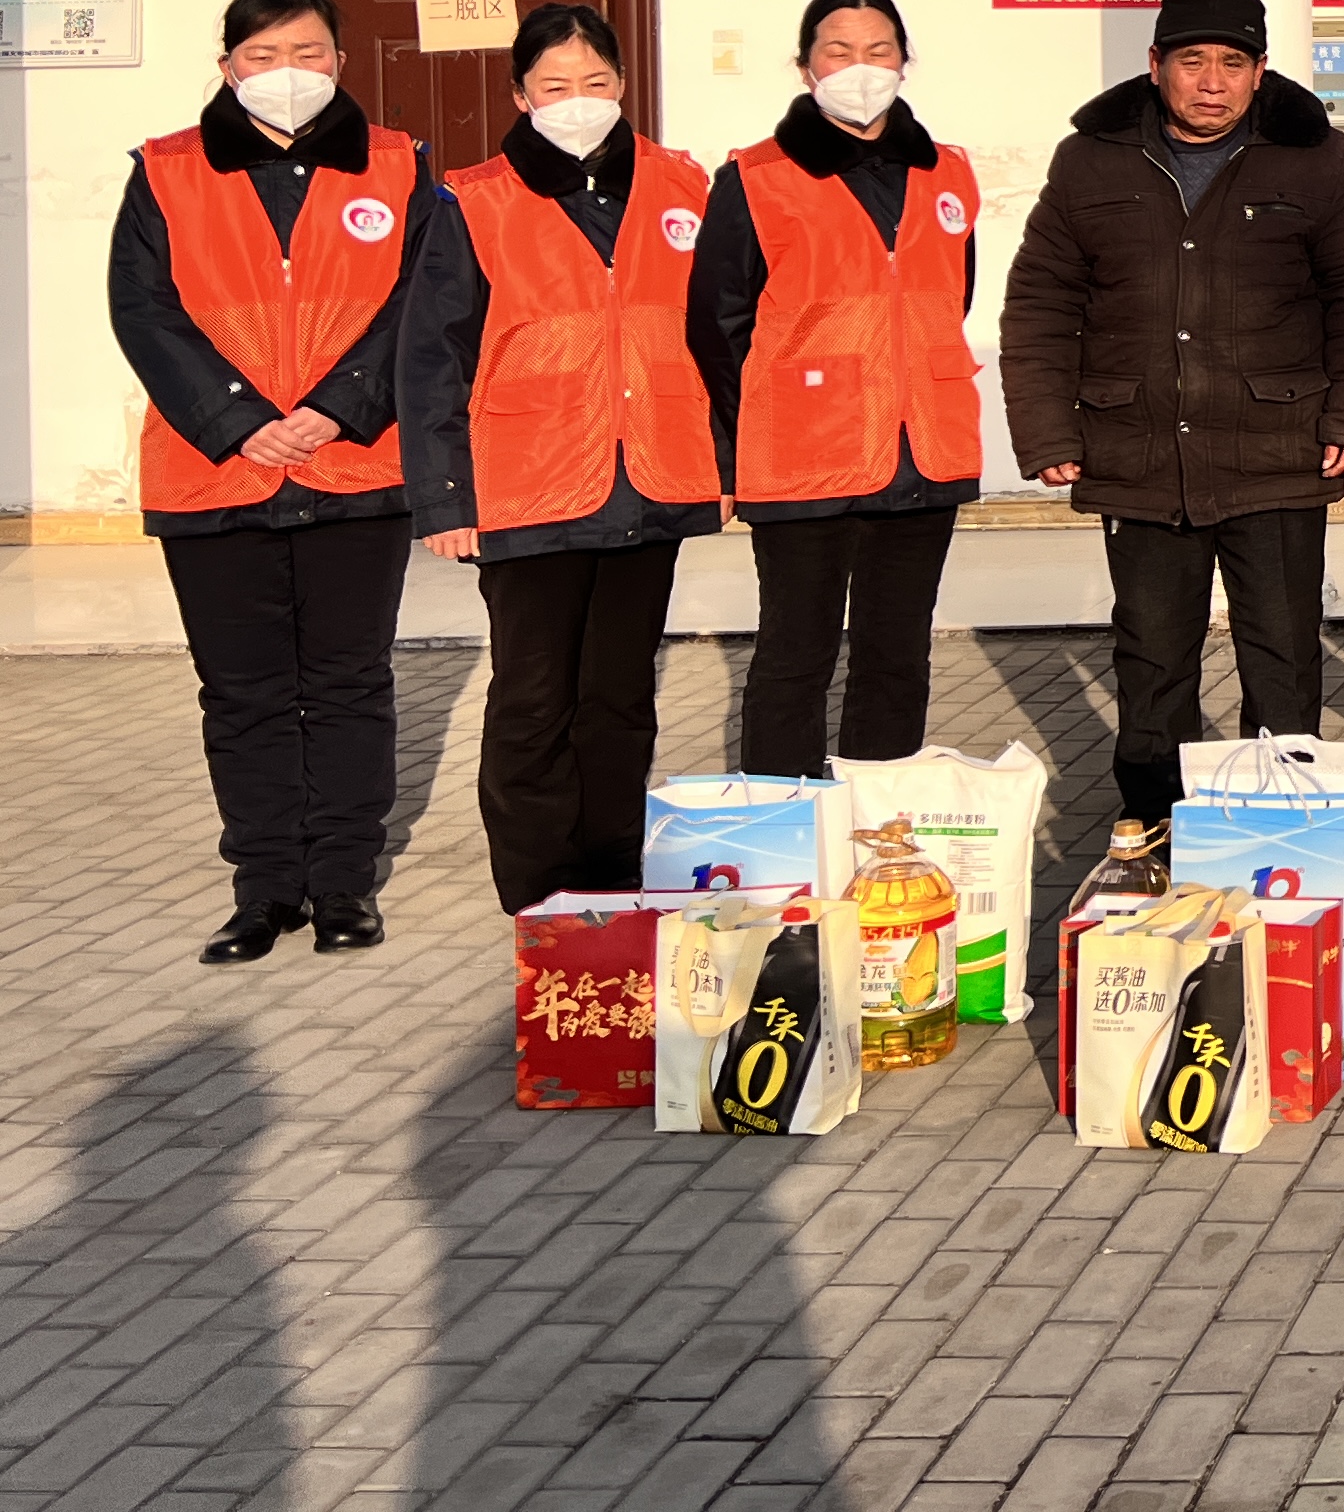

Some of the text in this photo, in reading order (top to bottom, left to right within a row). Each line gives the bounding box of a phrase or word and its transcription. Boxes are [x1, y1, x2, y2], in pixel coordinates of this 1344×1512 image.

[919, 813, 986, 825] 多用途小麦粉
[1094, 966, 1146, 987] 买酱油
[754, 997, 806, 1042] 千禾
[1093, 988, 1166, 1016] 选0添加
[1182, 1022, 1231, 1068] 千禾
[737, 1040, 788, 1109] 0
[722, 1098, 778, 1133] 零添加酱油
[1168, 1064, 1217, 1132] 0
